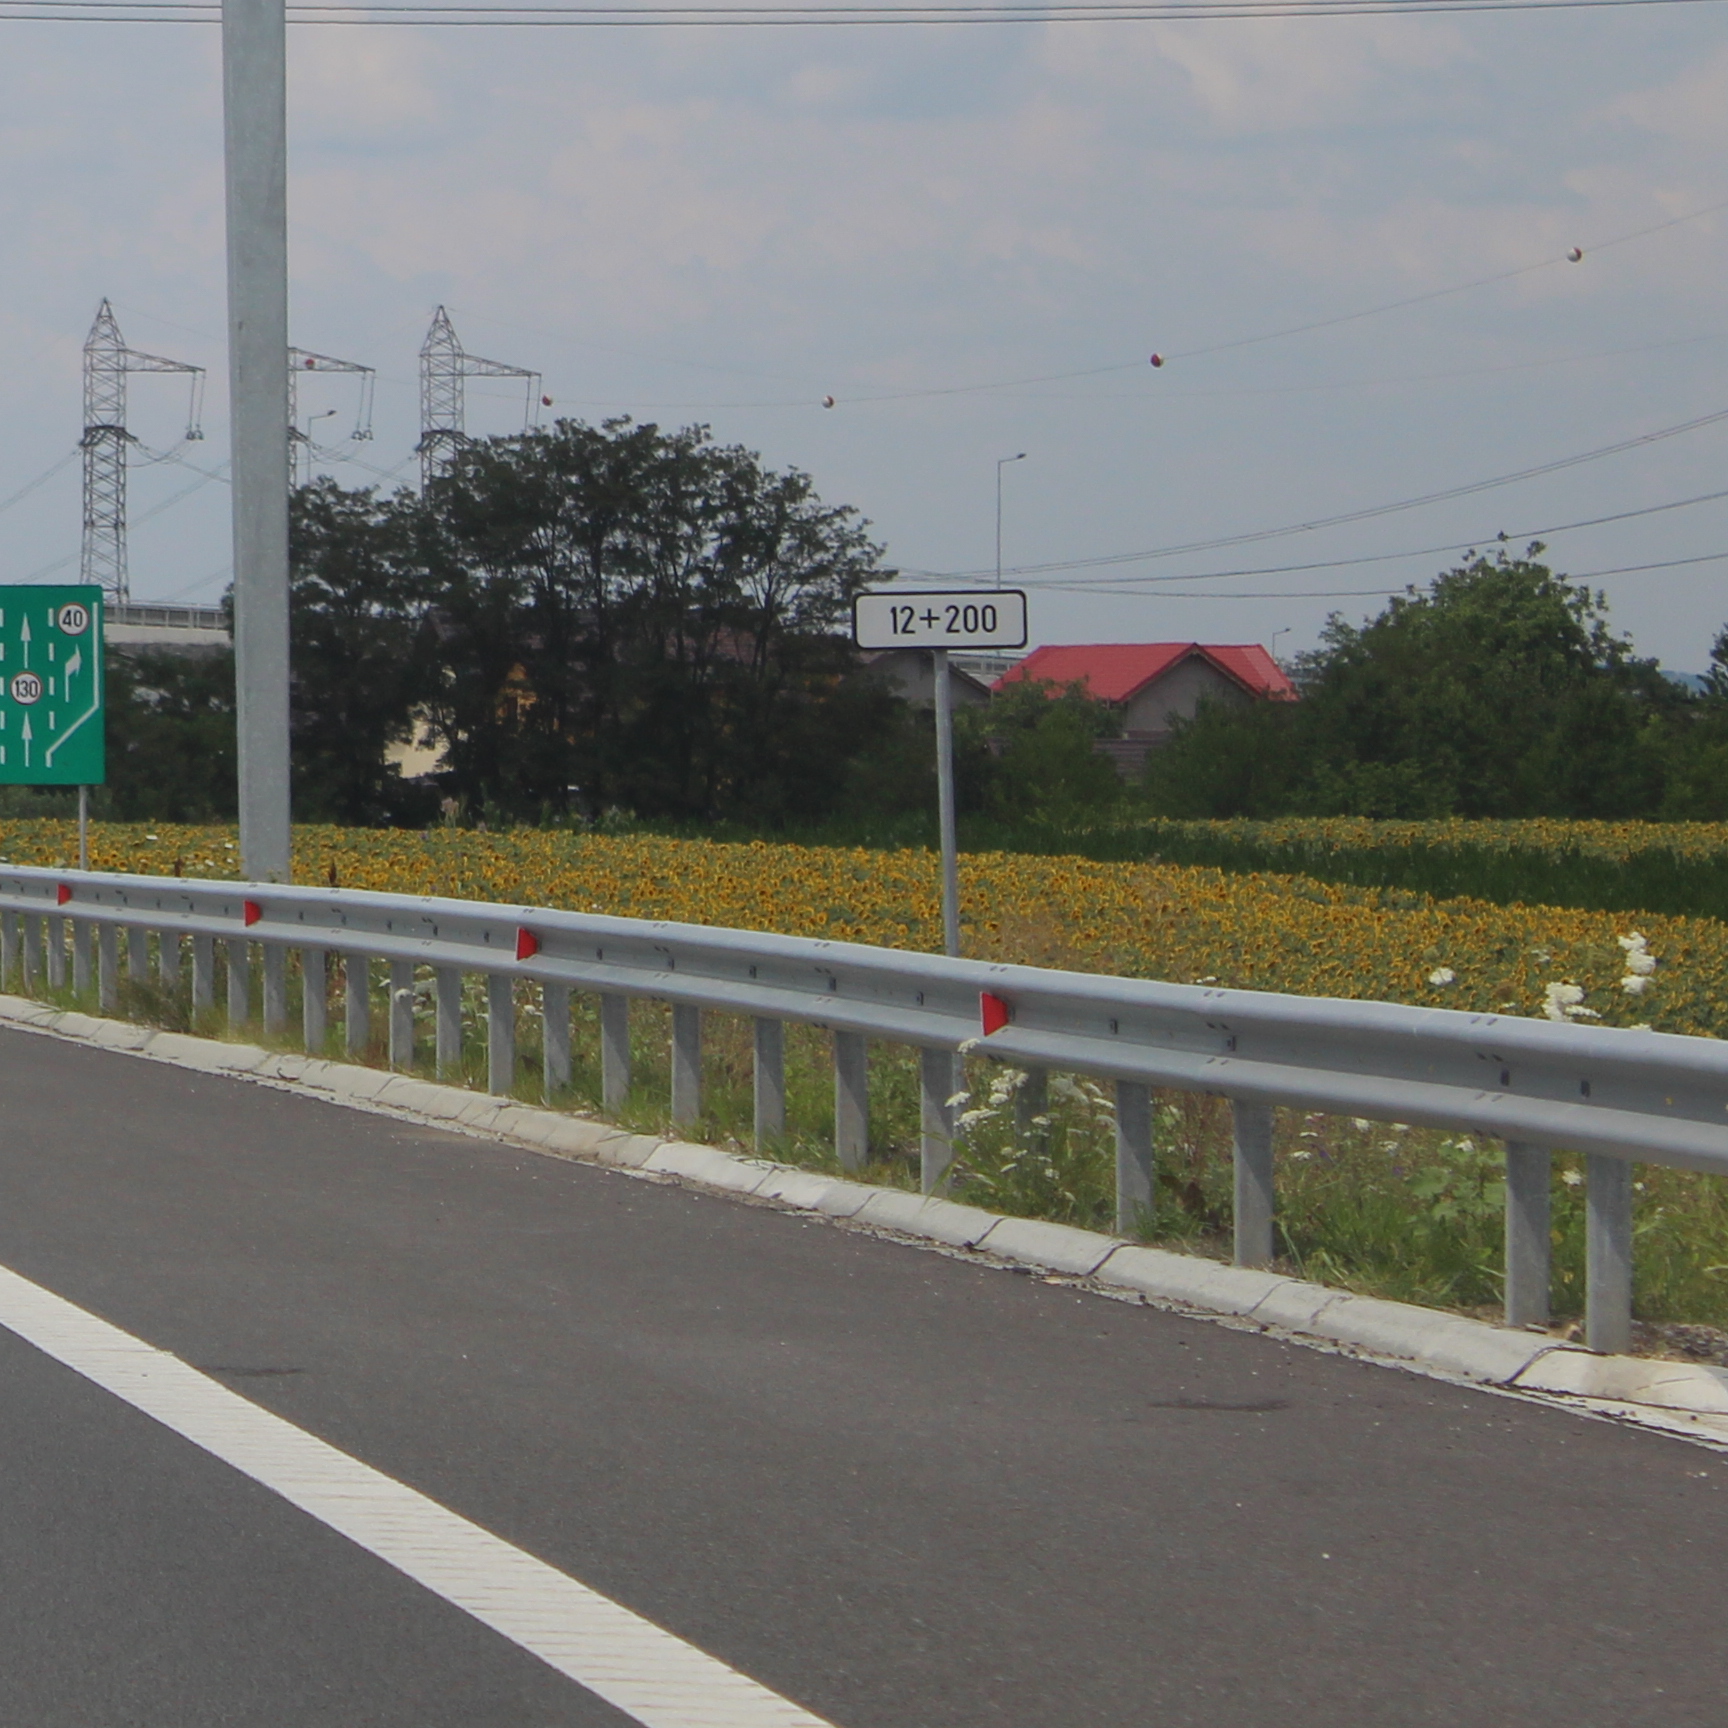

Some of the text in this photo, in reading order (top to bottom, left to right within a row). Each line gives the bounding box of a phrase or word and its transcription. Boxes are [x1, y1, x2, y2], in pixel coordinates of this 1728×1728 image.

[62, 610, 83, 627] 40
[889, 604, 998, 635] 12+200
[15, 680, 38, 697] 130
